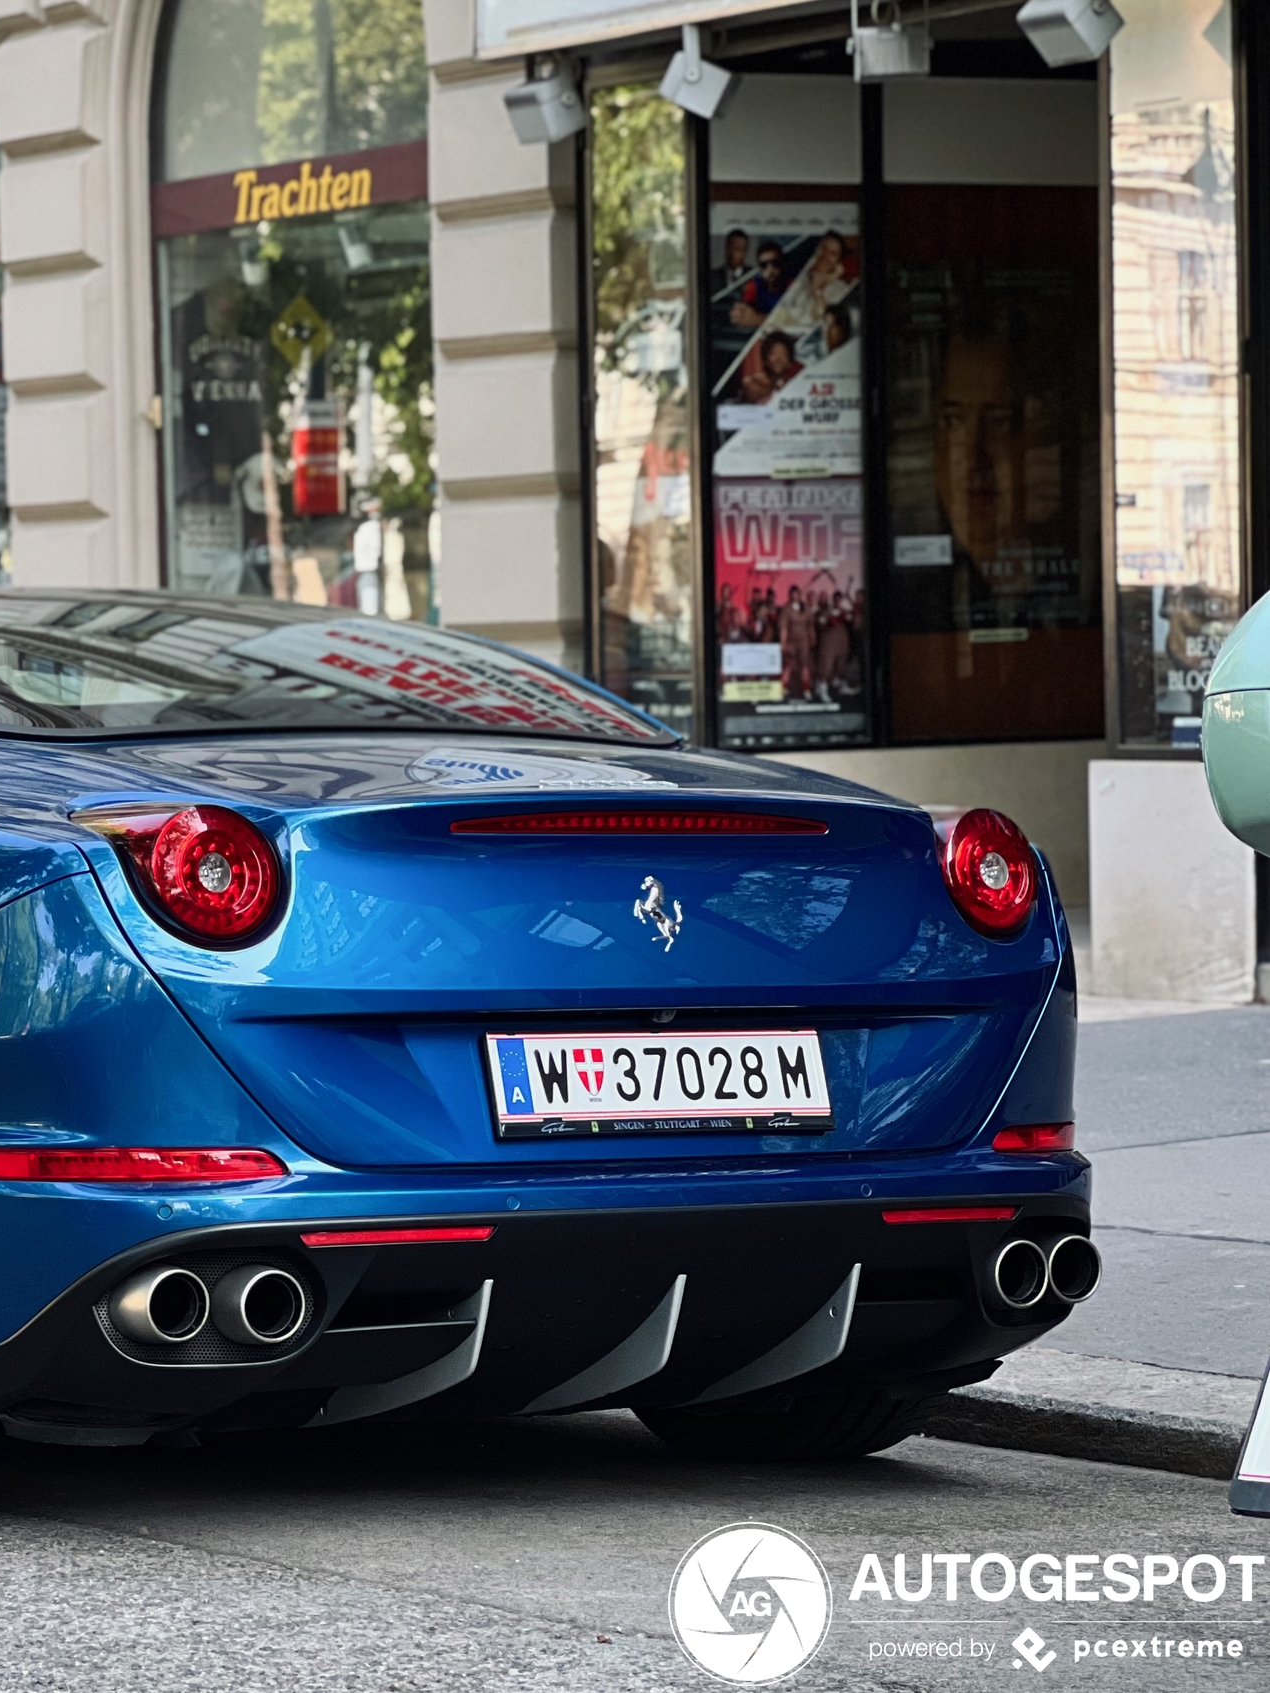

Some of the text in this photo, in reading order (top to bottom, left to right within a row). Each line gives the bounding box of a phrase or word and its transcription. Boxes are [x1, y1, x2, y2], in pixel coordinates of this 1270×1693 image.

[233, 161, 372, 224] Trachten
[719, 509, 863, 563] WTF
[512, 1045, 812, 1104] A W 37028 M
[613, 1120, 646, 1131] SINGEN
[654, 1119, 701, 1130] STUTTGART
[709, 1118, 733, 1129] WIEN
